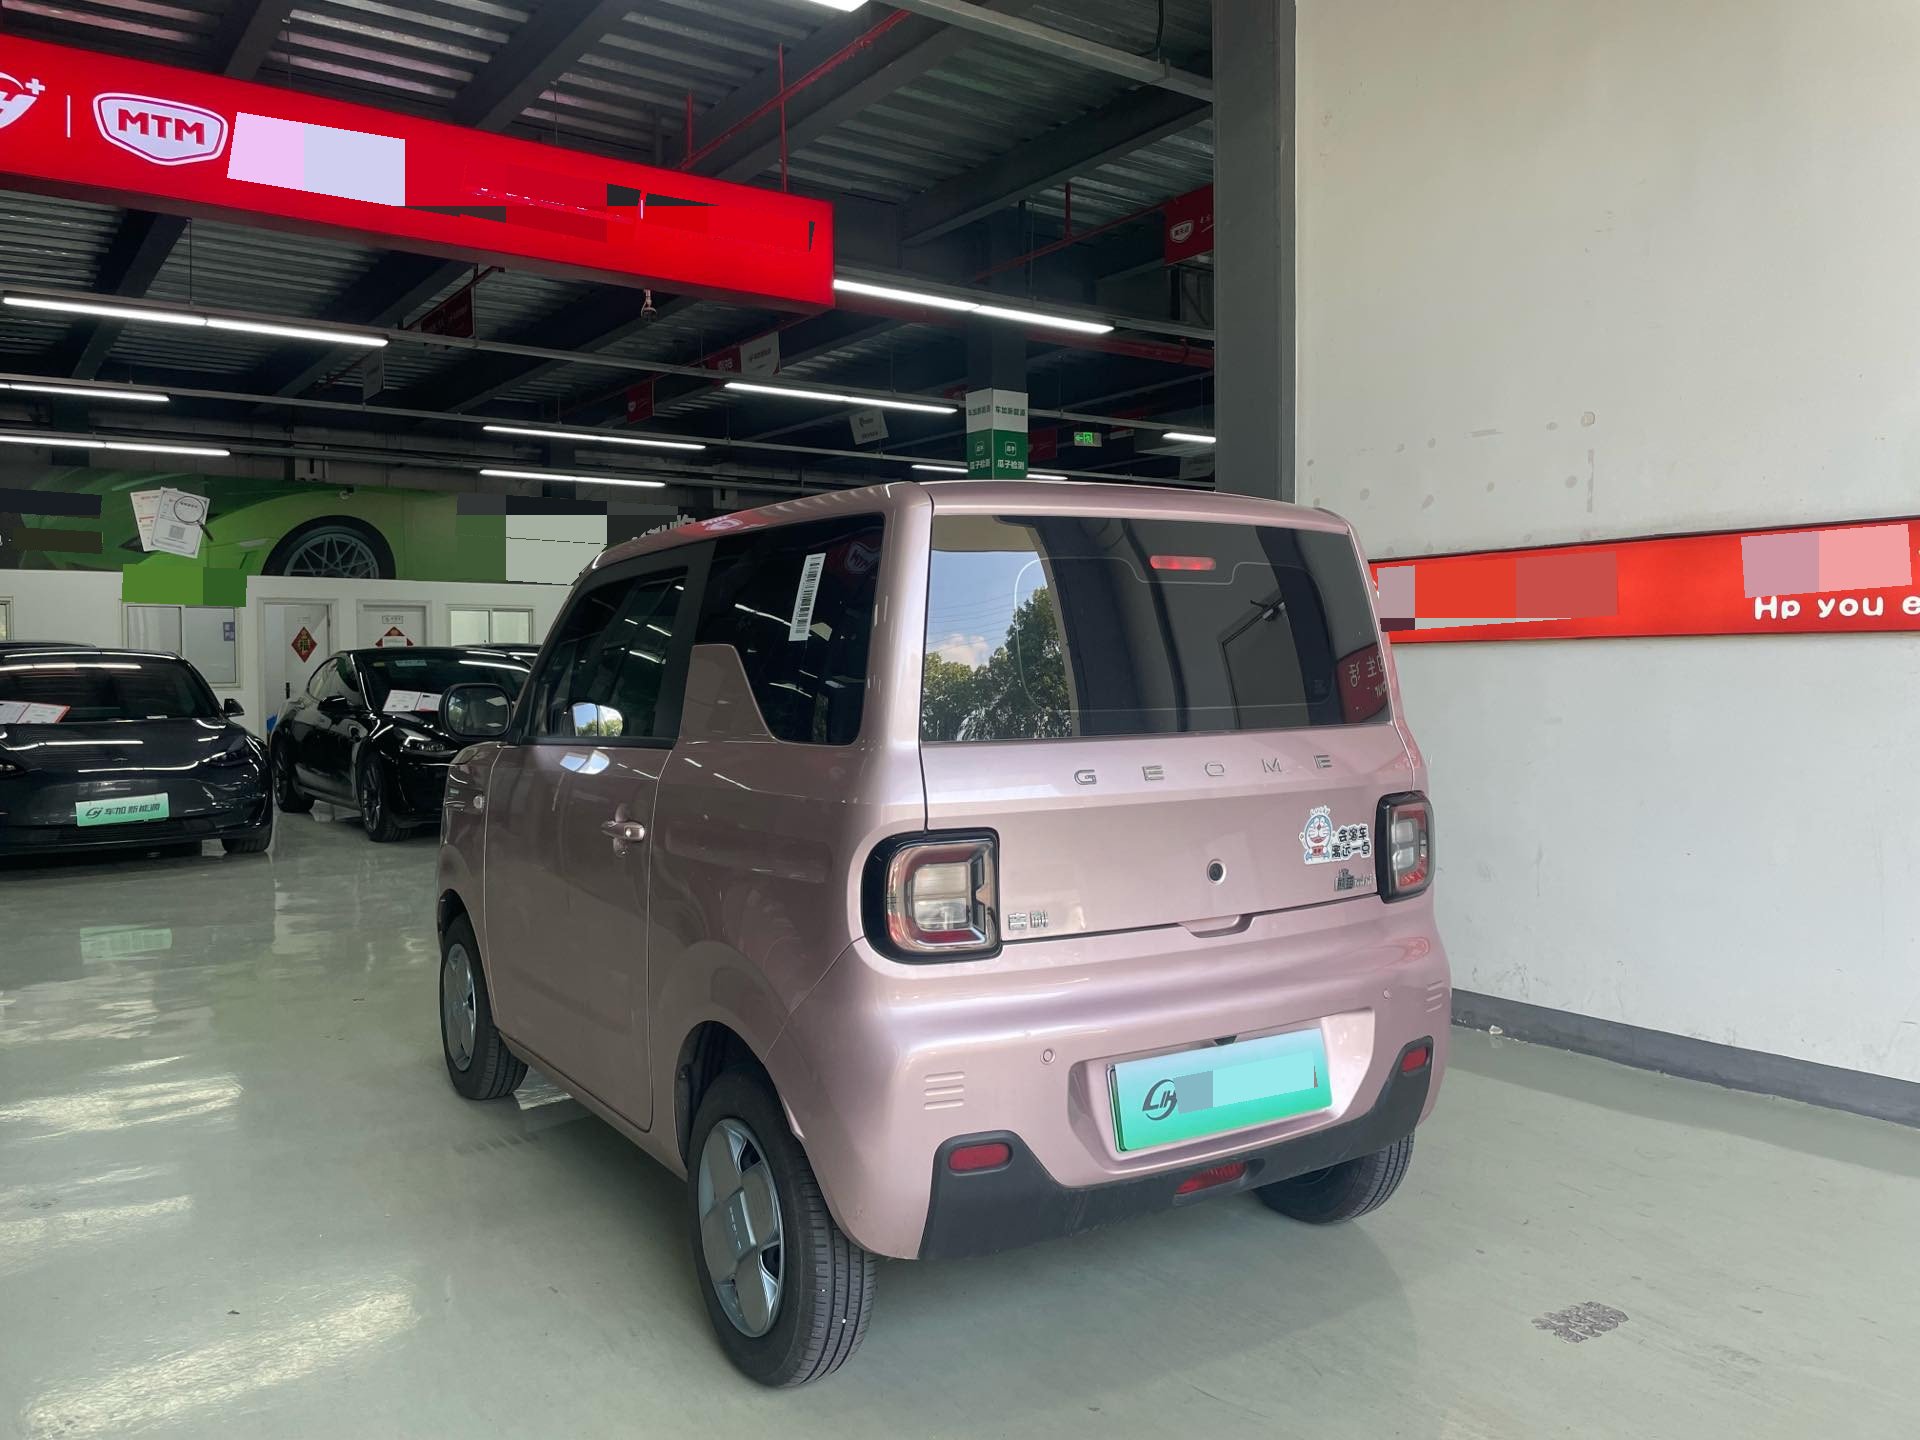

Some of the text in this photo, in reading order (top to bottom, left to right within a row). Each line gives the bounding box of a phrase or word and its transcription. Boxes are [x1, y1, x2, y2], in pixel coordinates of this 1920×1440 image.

[117, 108, 205, 145] MTM
[1817, 597, 1884, 618] you
[1074, 754, 1332, 786] GEOME
